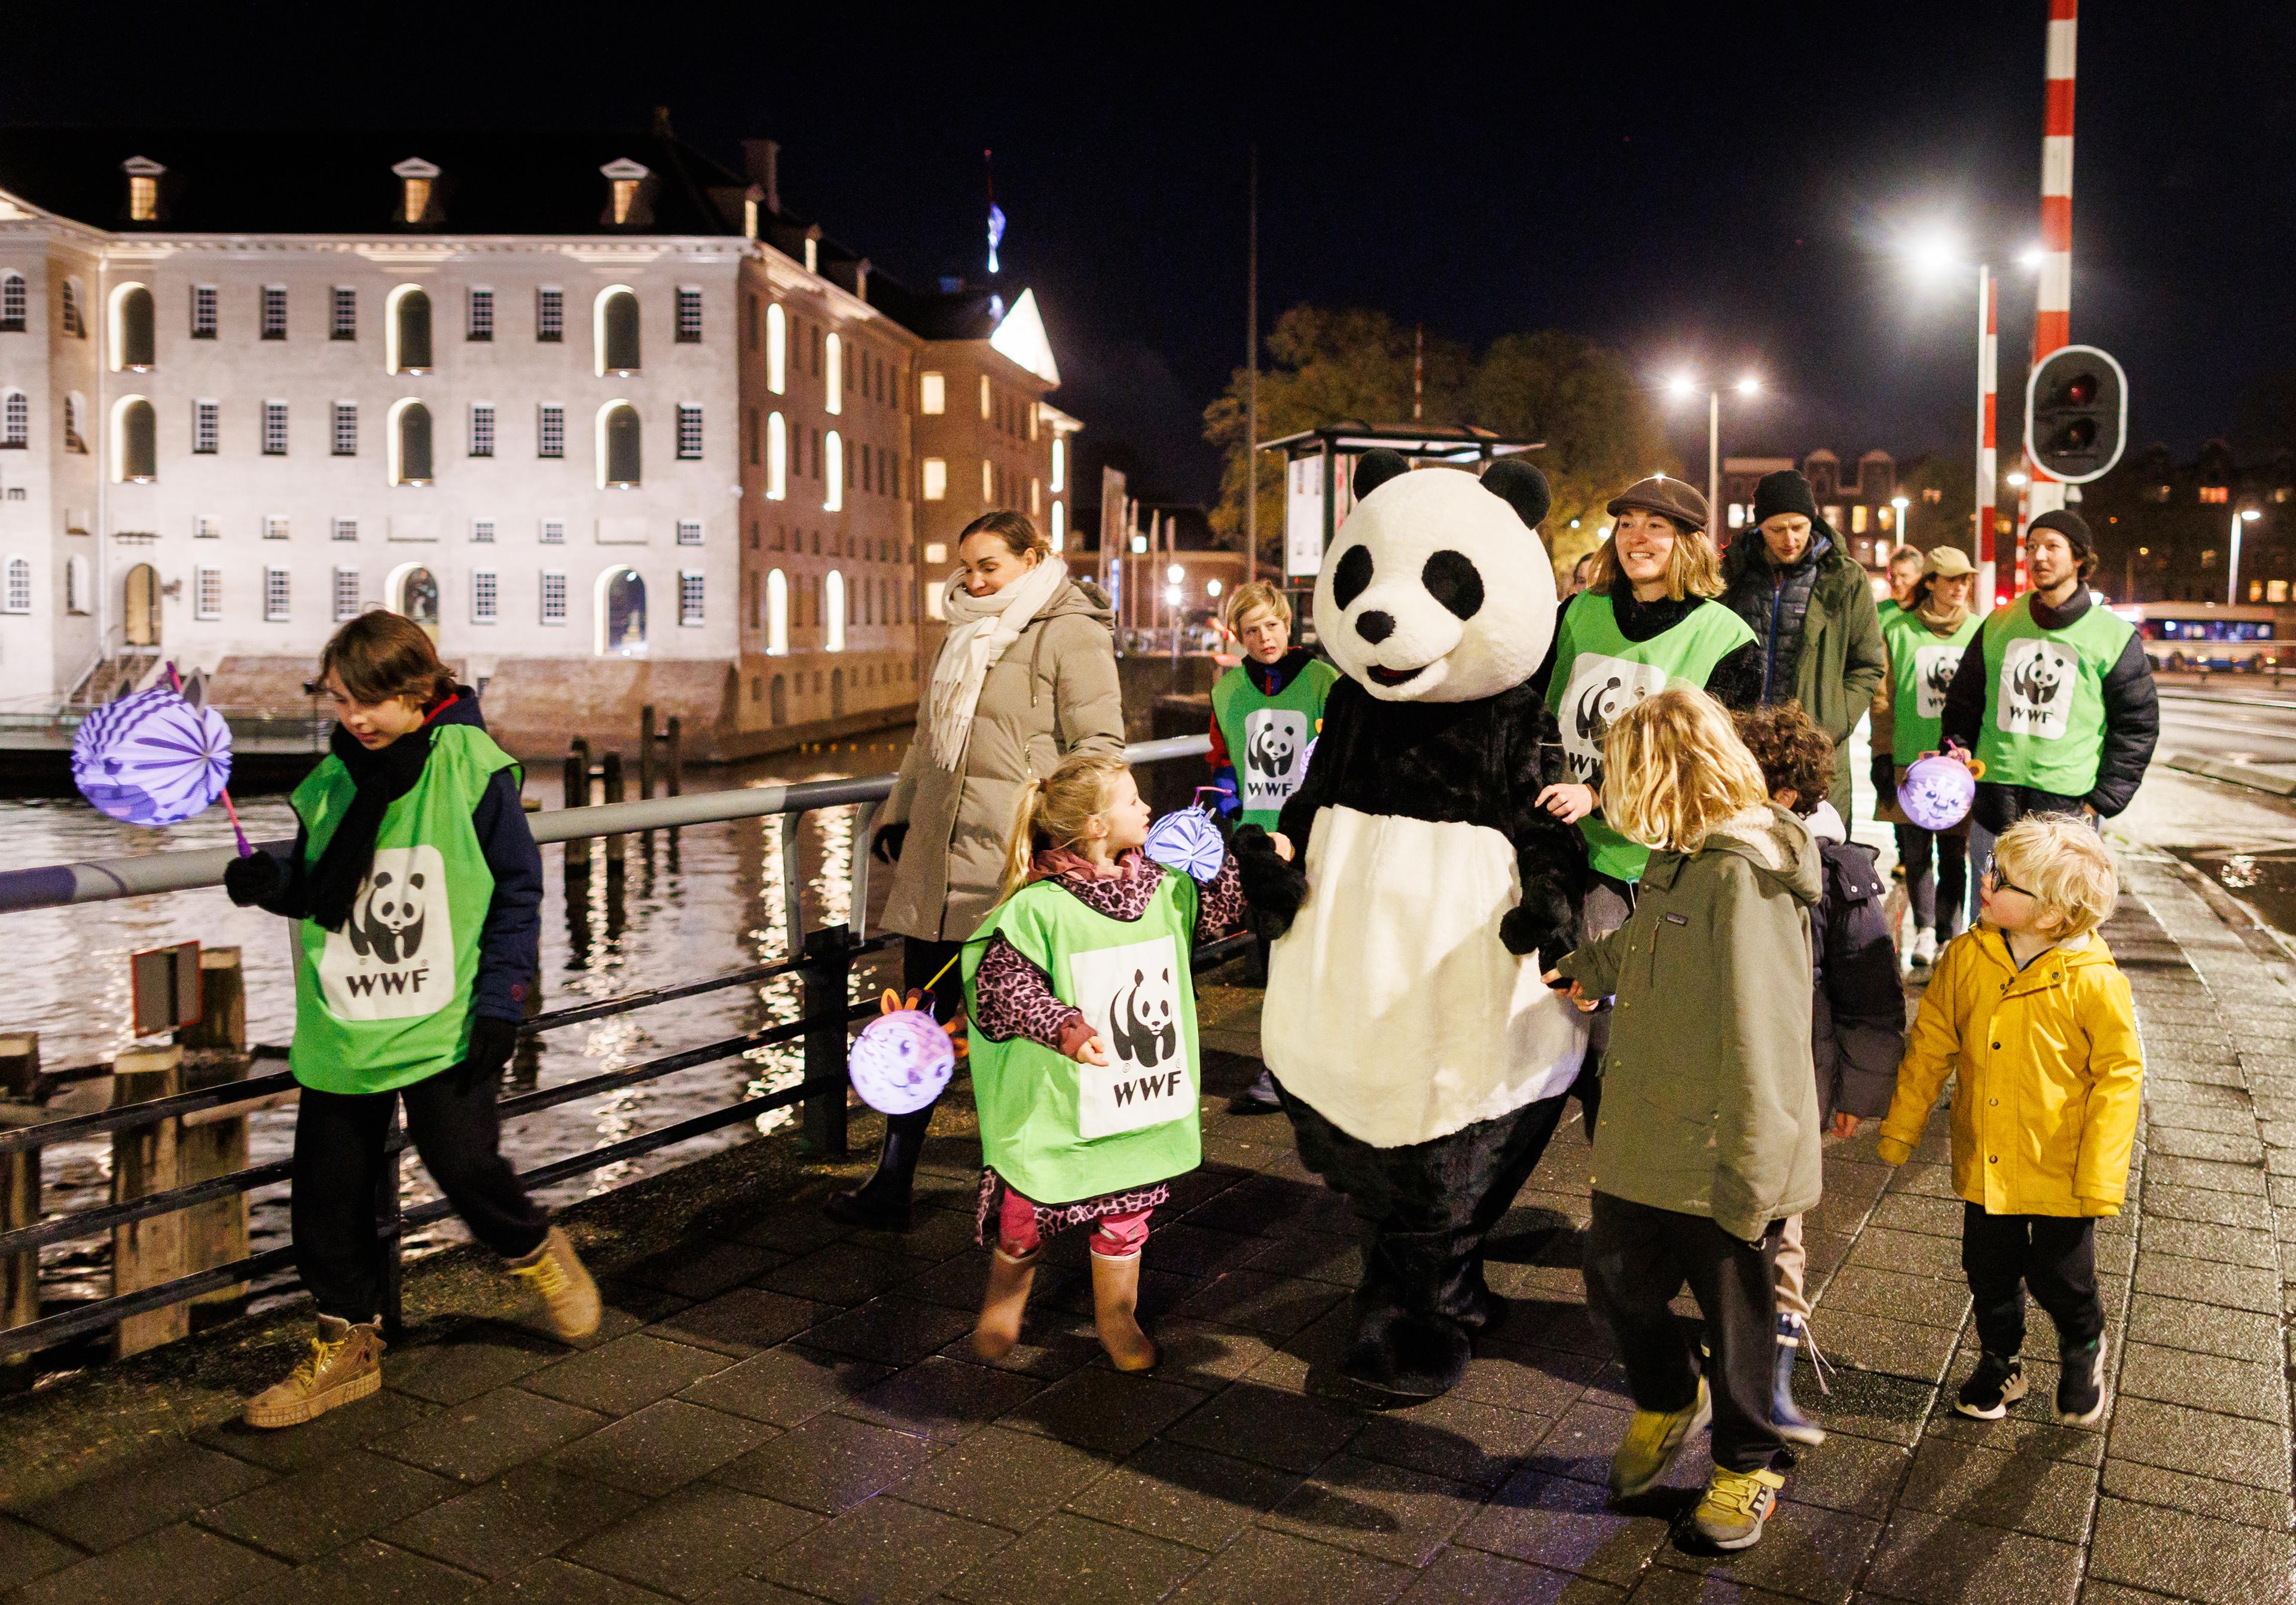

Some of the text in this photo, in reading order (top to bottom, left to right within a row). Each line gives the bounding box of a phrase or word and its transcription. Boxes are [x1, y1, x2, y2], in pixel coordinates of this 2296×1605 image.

[2010, 705, 2053, 724] WWF
[1247, 782, 1293, 797] WWF
[346, 968, 429, 998] WWF
[1113, 1070, 1181, 1108] WWF
